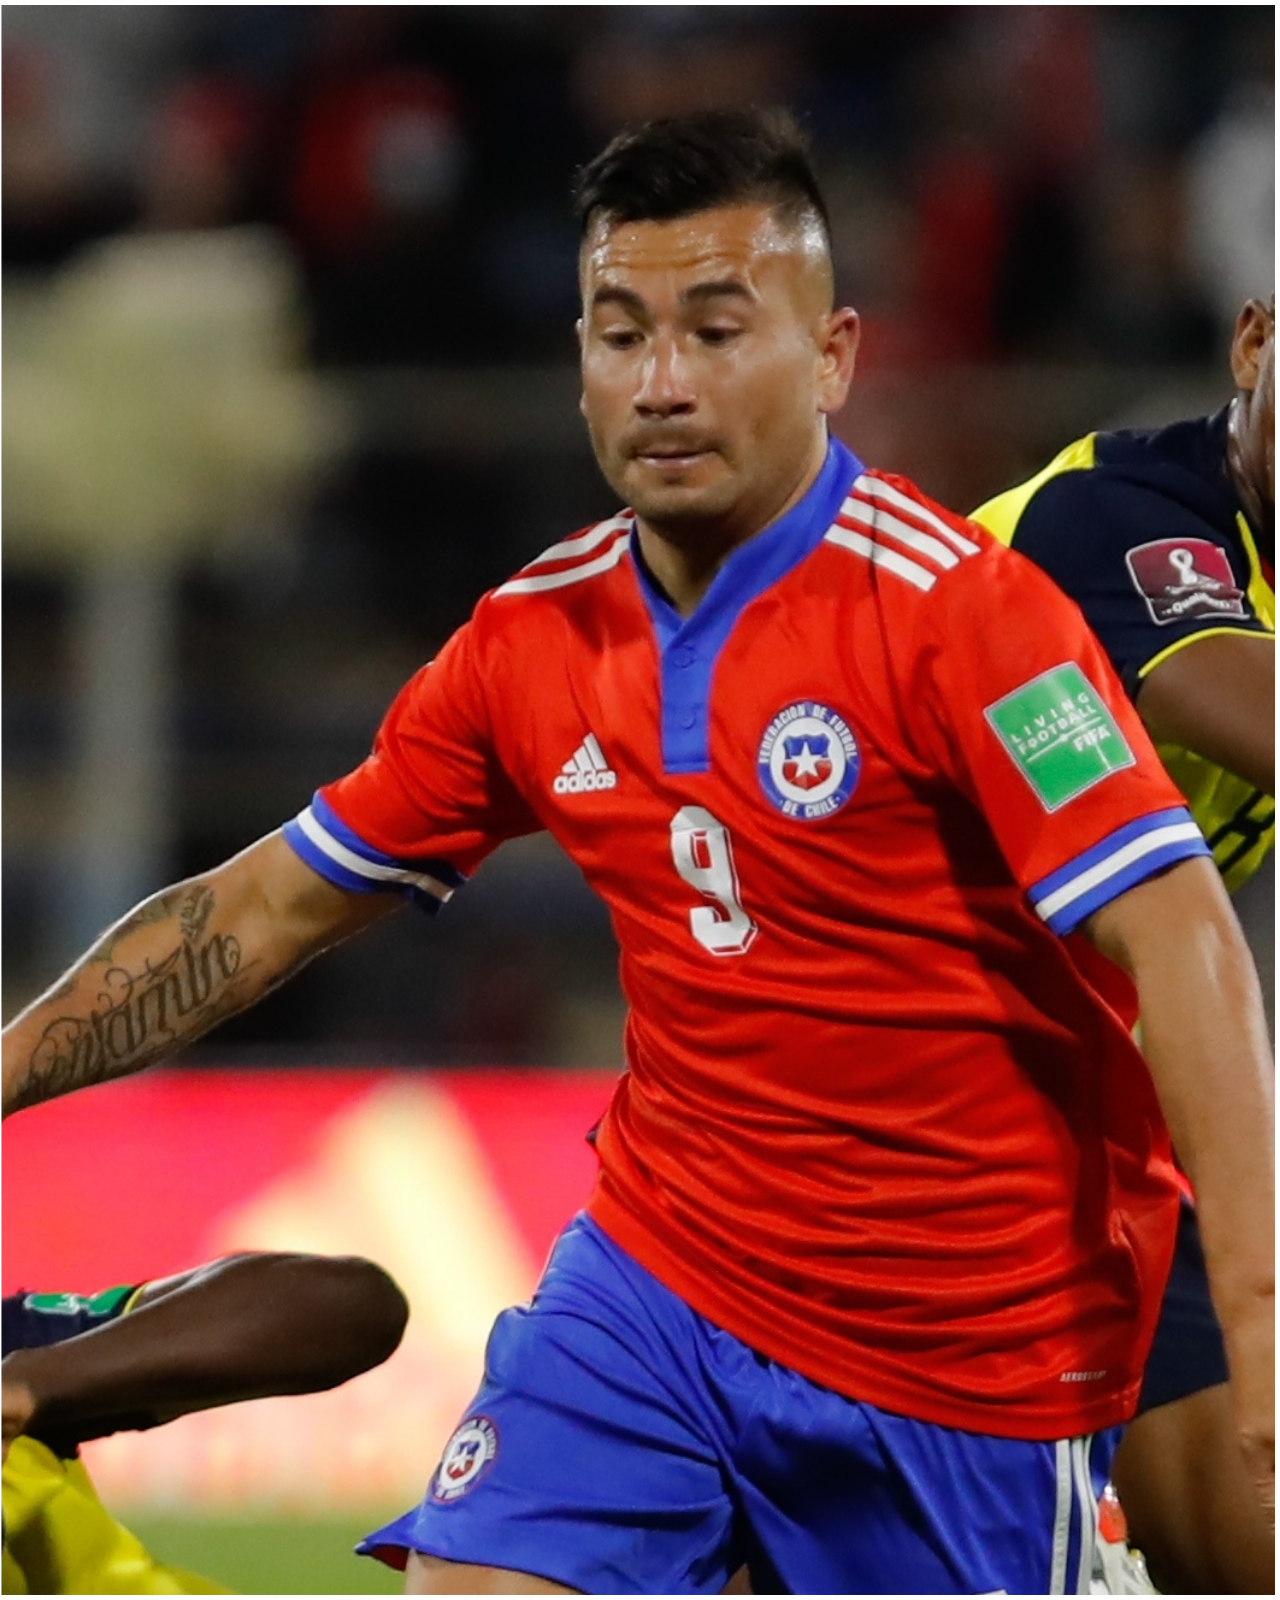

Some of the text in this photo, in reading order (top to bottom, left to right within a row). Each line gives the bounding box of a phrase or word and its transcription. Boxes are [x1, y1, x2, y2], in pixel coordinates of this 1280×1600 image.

[758, 703, 858, 763] FEDERACION DE FUTBOL
[1011, 692, 1090, 744] LIVING
[1017, 704, 1097, 755] FOOTBALL
[1073, 724, 1111, 751] FIFA
[553, 769, 617, 794] adidas
[782, 795, 838, 818] DE CHILE
[670, 805, 758, 957] 9
